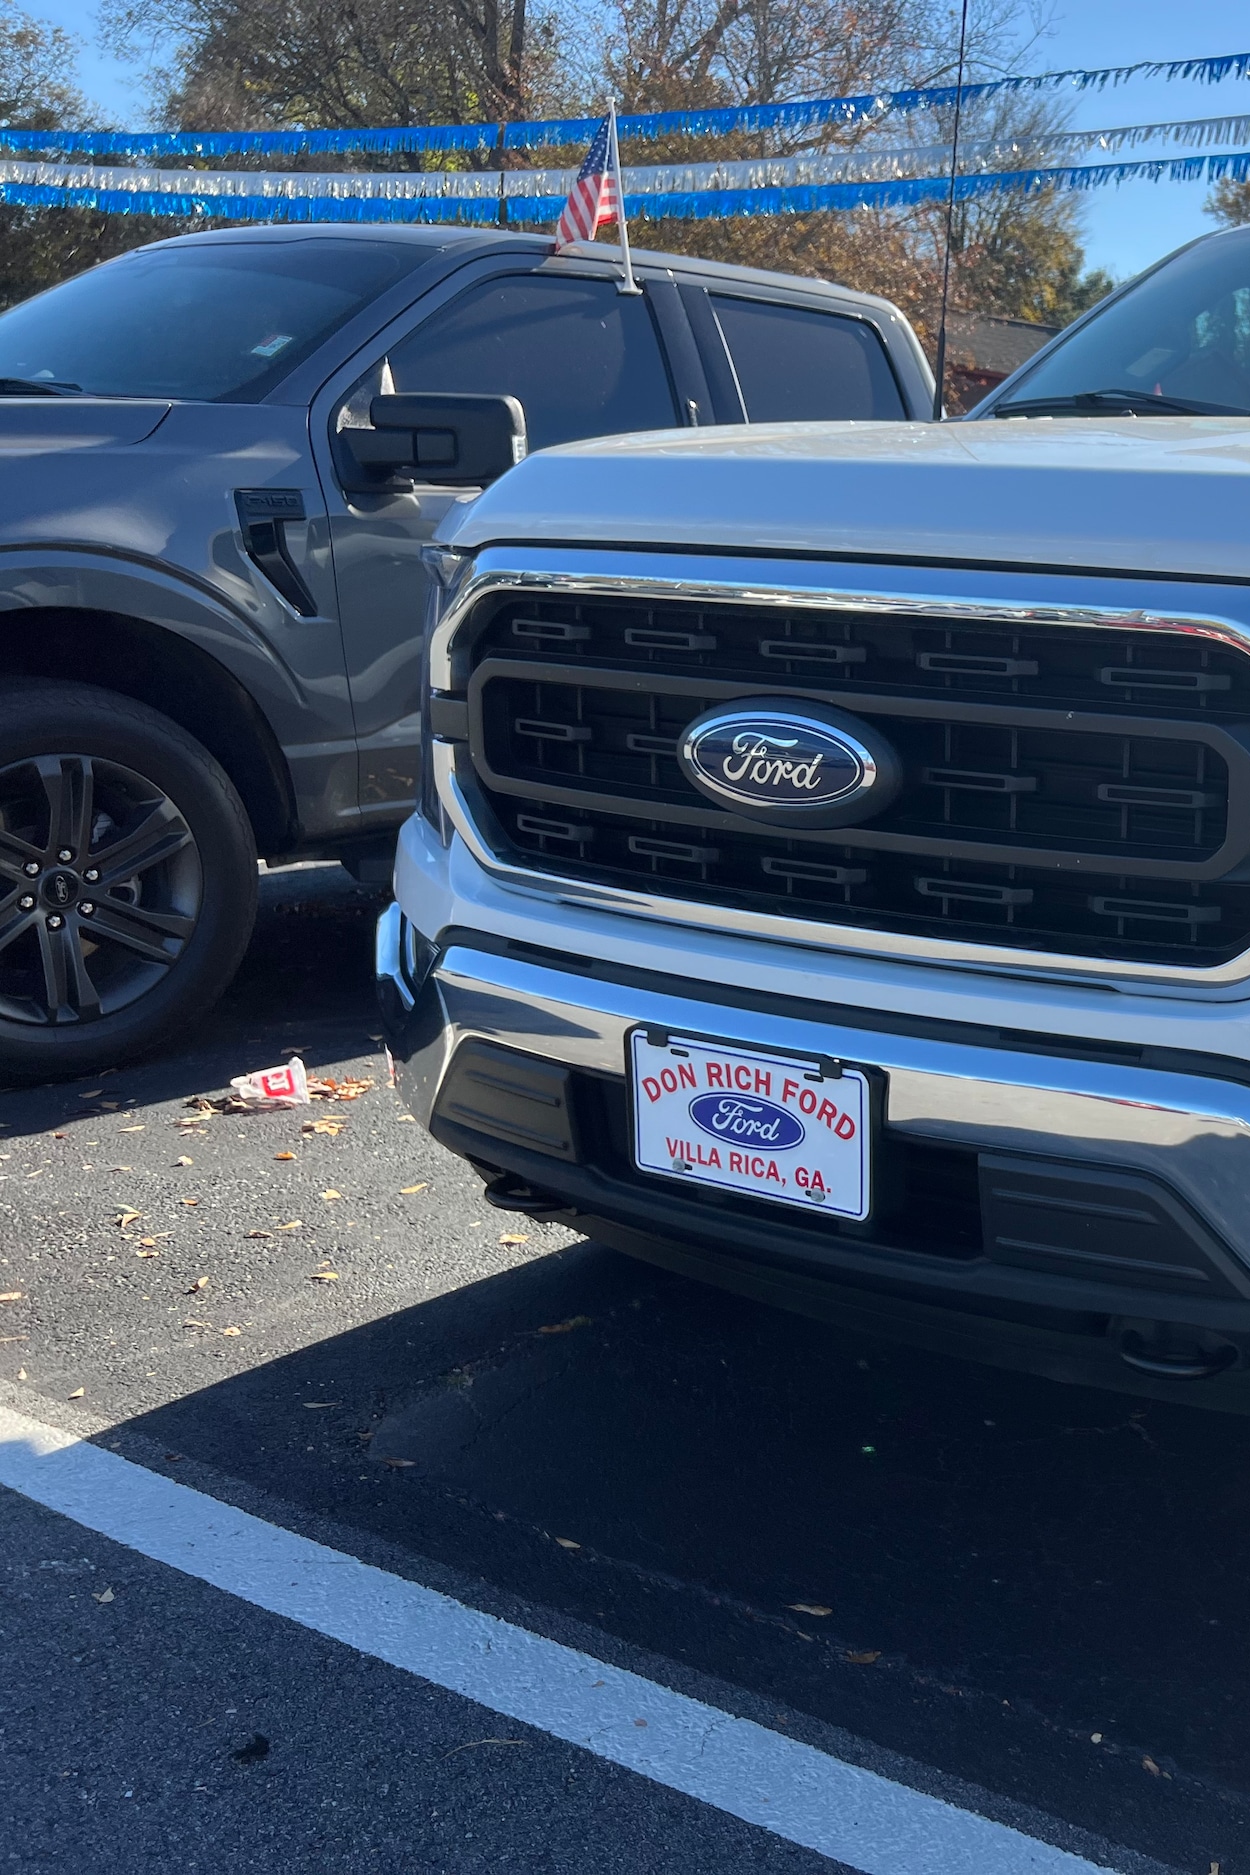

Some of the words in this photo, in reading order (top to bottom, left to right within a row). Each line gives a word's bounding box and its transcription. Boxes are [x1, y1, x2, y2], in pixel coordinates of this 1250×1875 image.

[722, 732, 824, 789] Ford
[641, 1062, 697, 1103] DON
[705, 1062, 771, 1096] RICH
[781, 1078, 856, 1141] FORD
[711, 1099, 781, 1141] Ford
[665, 1137, 722, 1169] VILLA
[729, 1151, 787, 1187] RICA,
[794, 1167, 832, 1193] GA.
